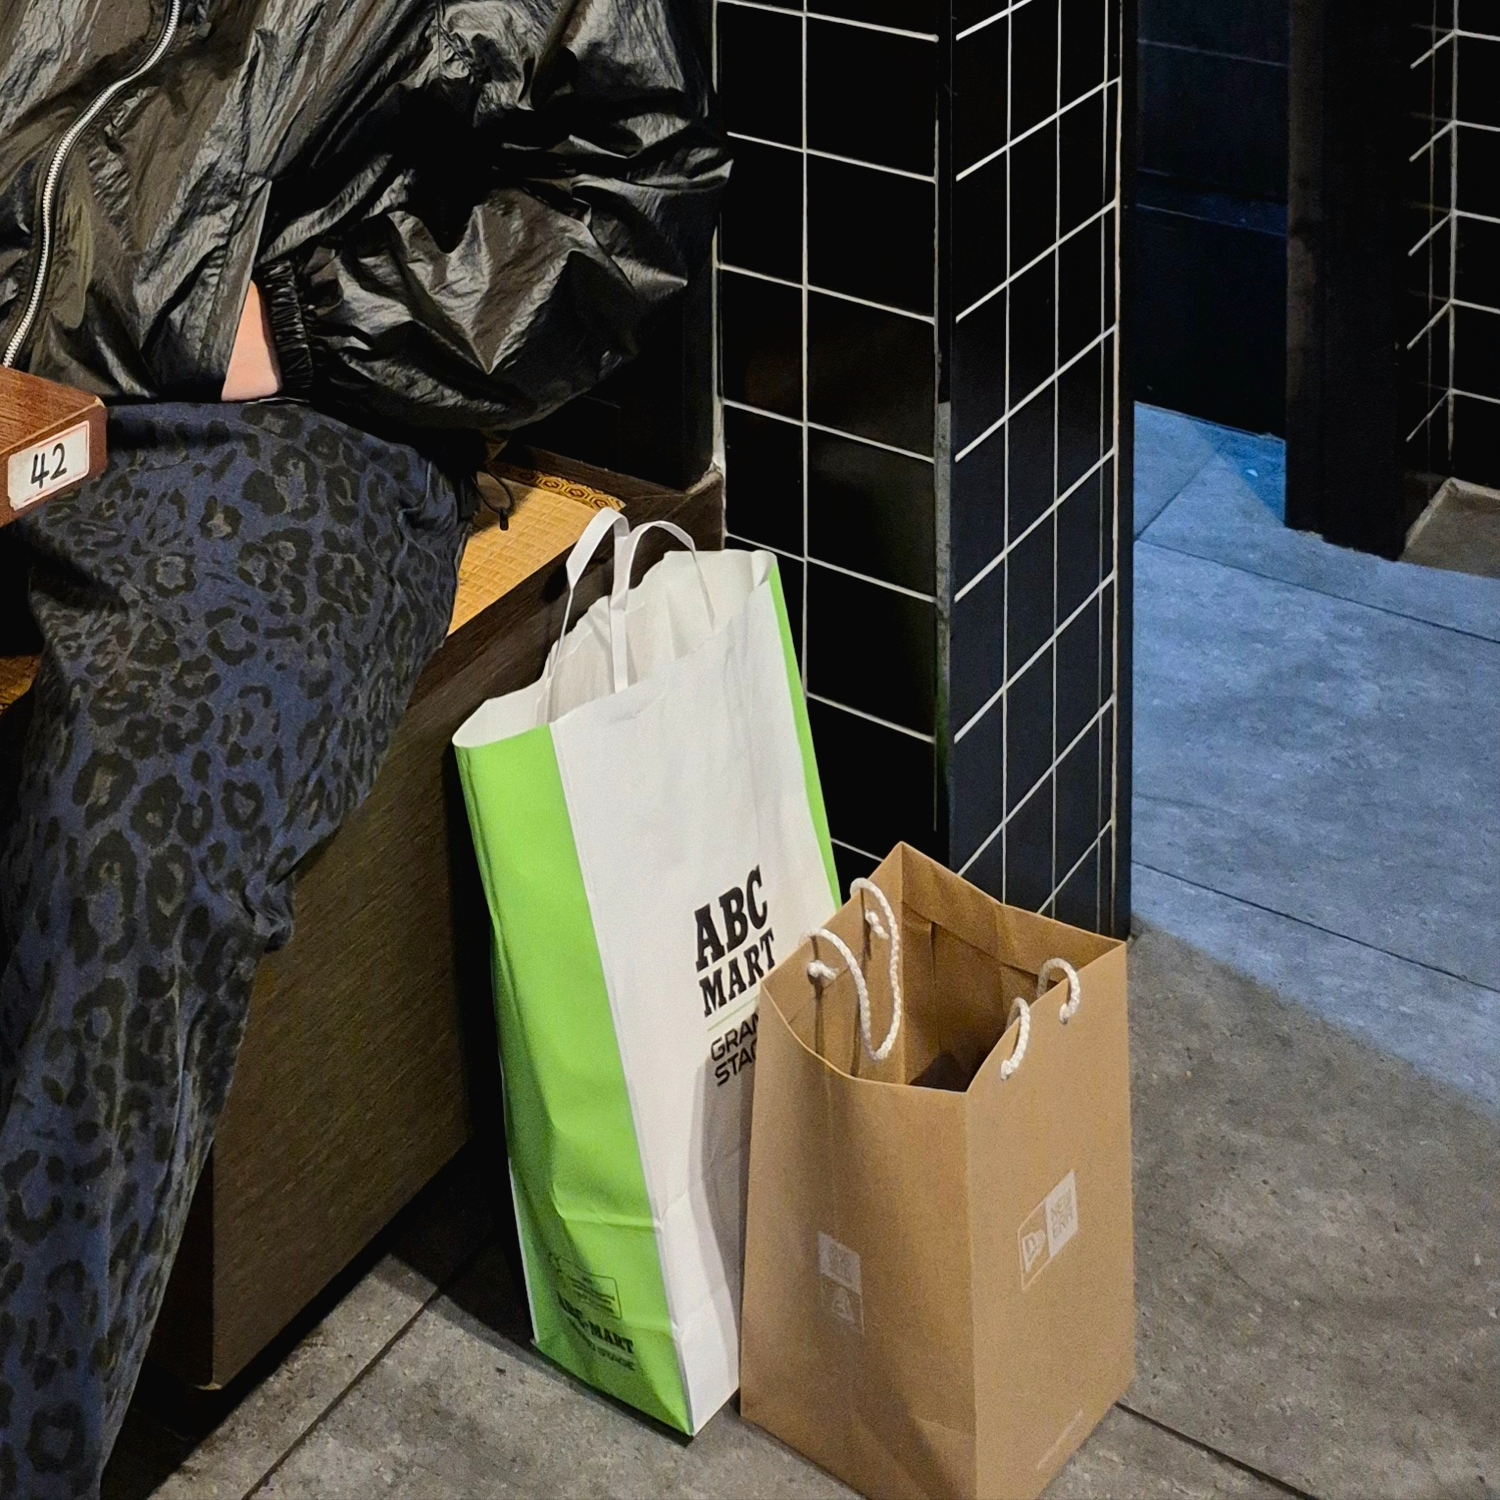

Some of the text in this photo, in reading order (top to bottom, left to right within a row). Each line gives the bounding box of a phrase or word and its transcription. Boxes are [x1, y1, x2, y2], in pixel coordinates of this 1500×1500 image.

[30, 442, 68, 489] 42
[694, 864, 768, 973] ABC
[698, 928, 776, 1018] MART
